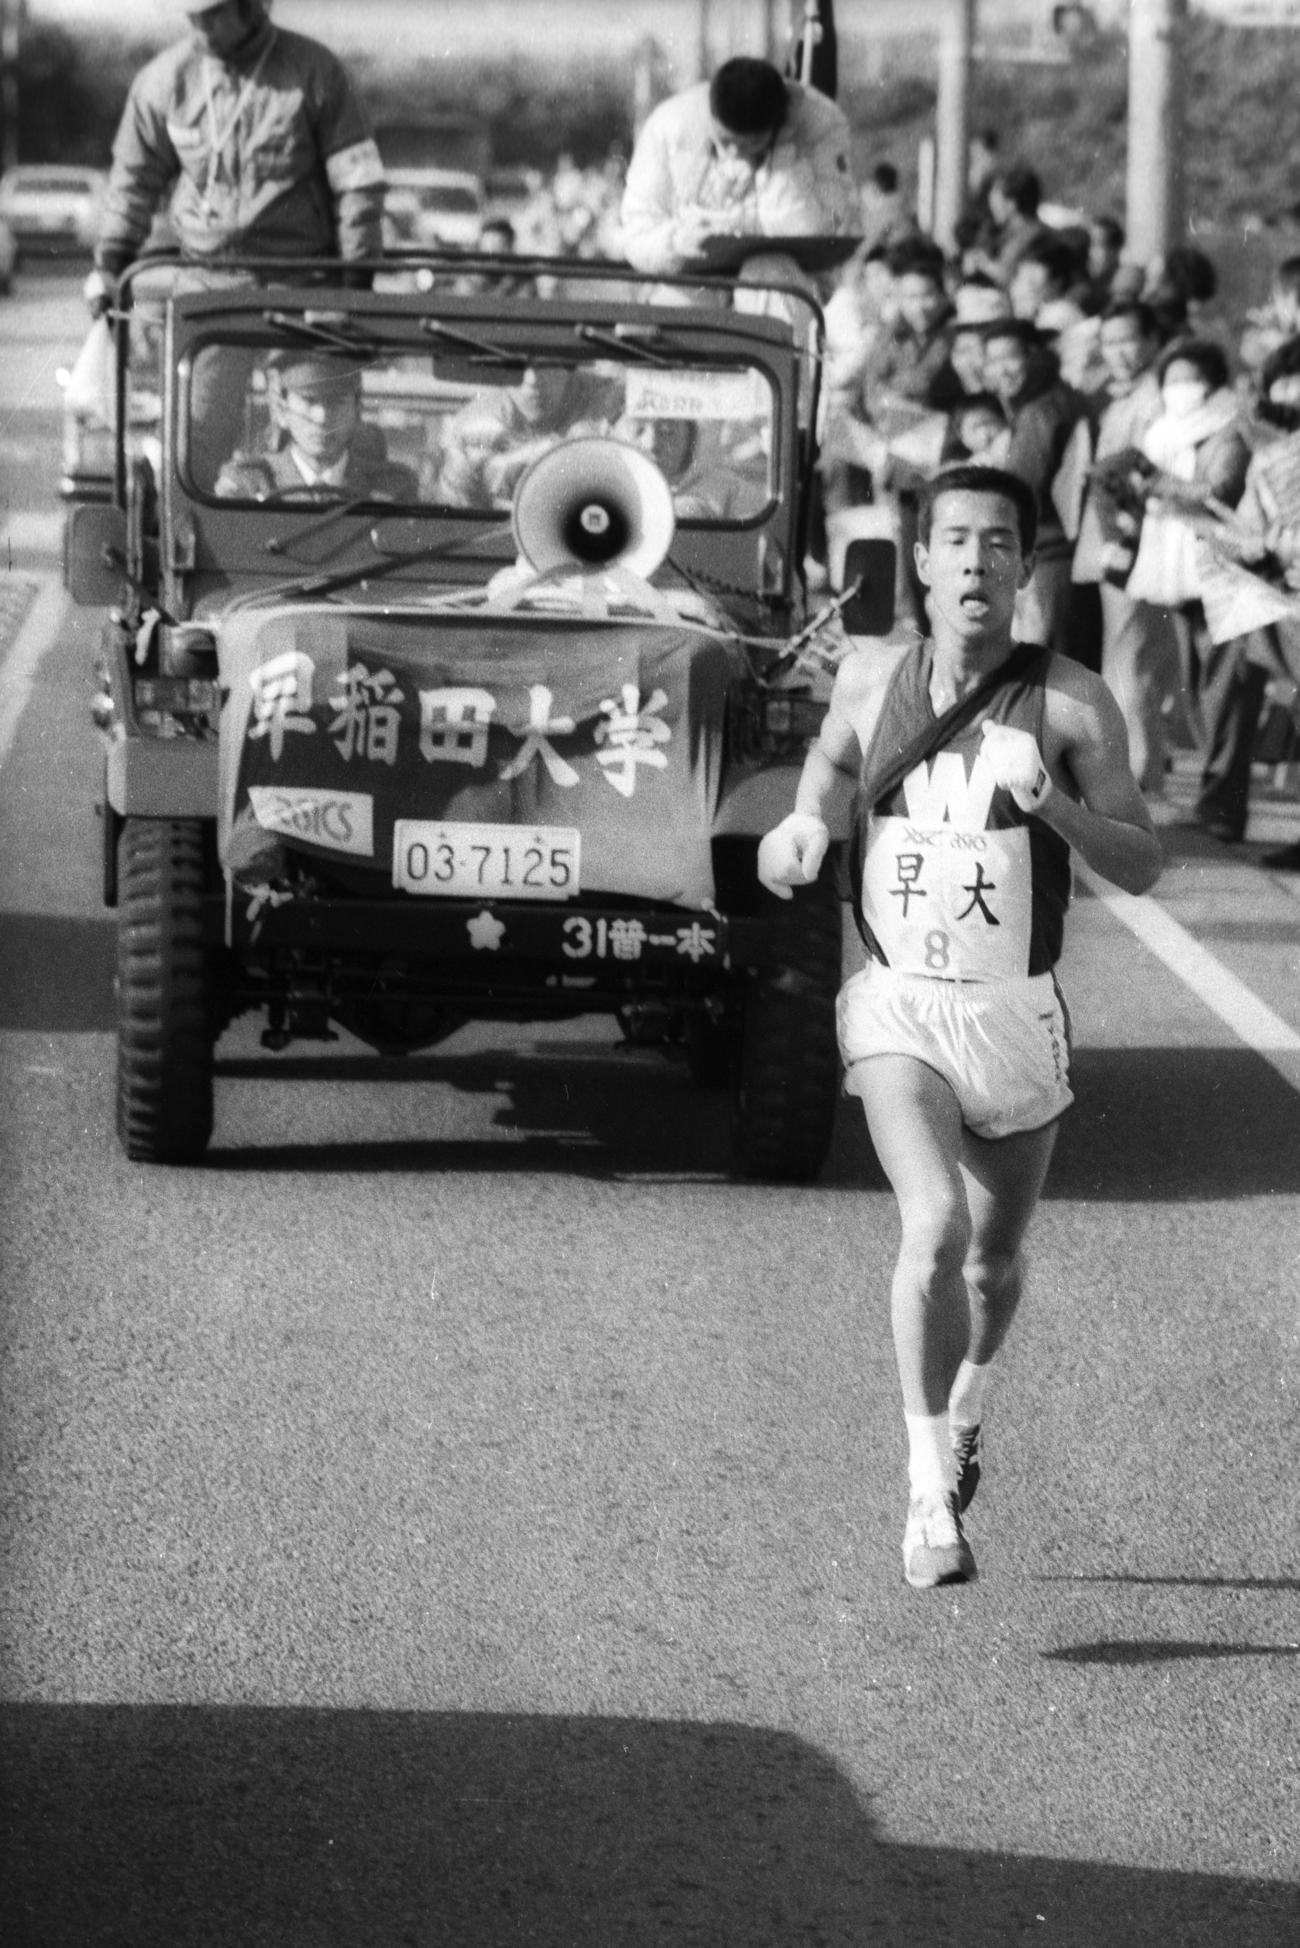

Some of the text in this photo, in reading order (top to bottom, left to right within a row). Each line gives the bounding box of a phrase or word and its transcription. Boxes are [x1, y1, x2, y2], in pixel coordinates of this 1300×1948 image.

[248, 651, 671, 797] 早稲田大学
[924, 930, 949, 969] 8
